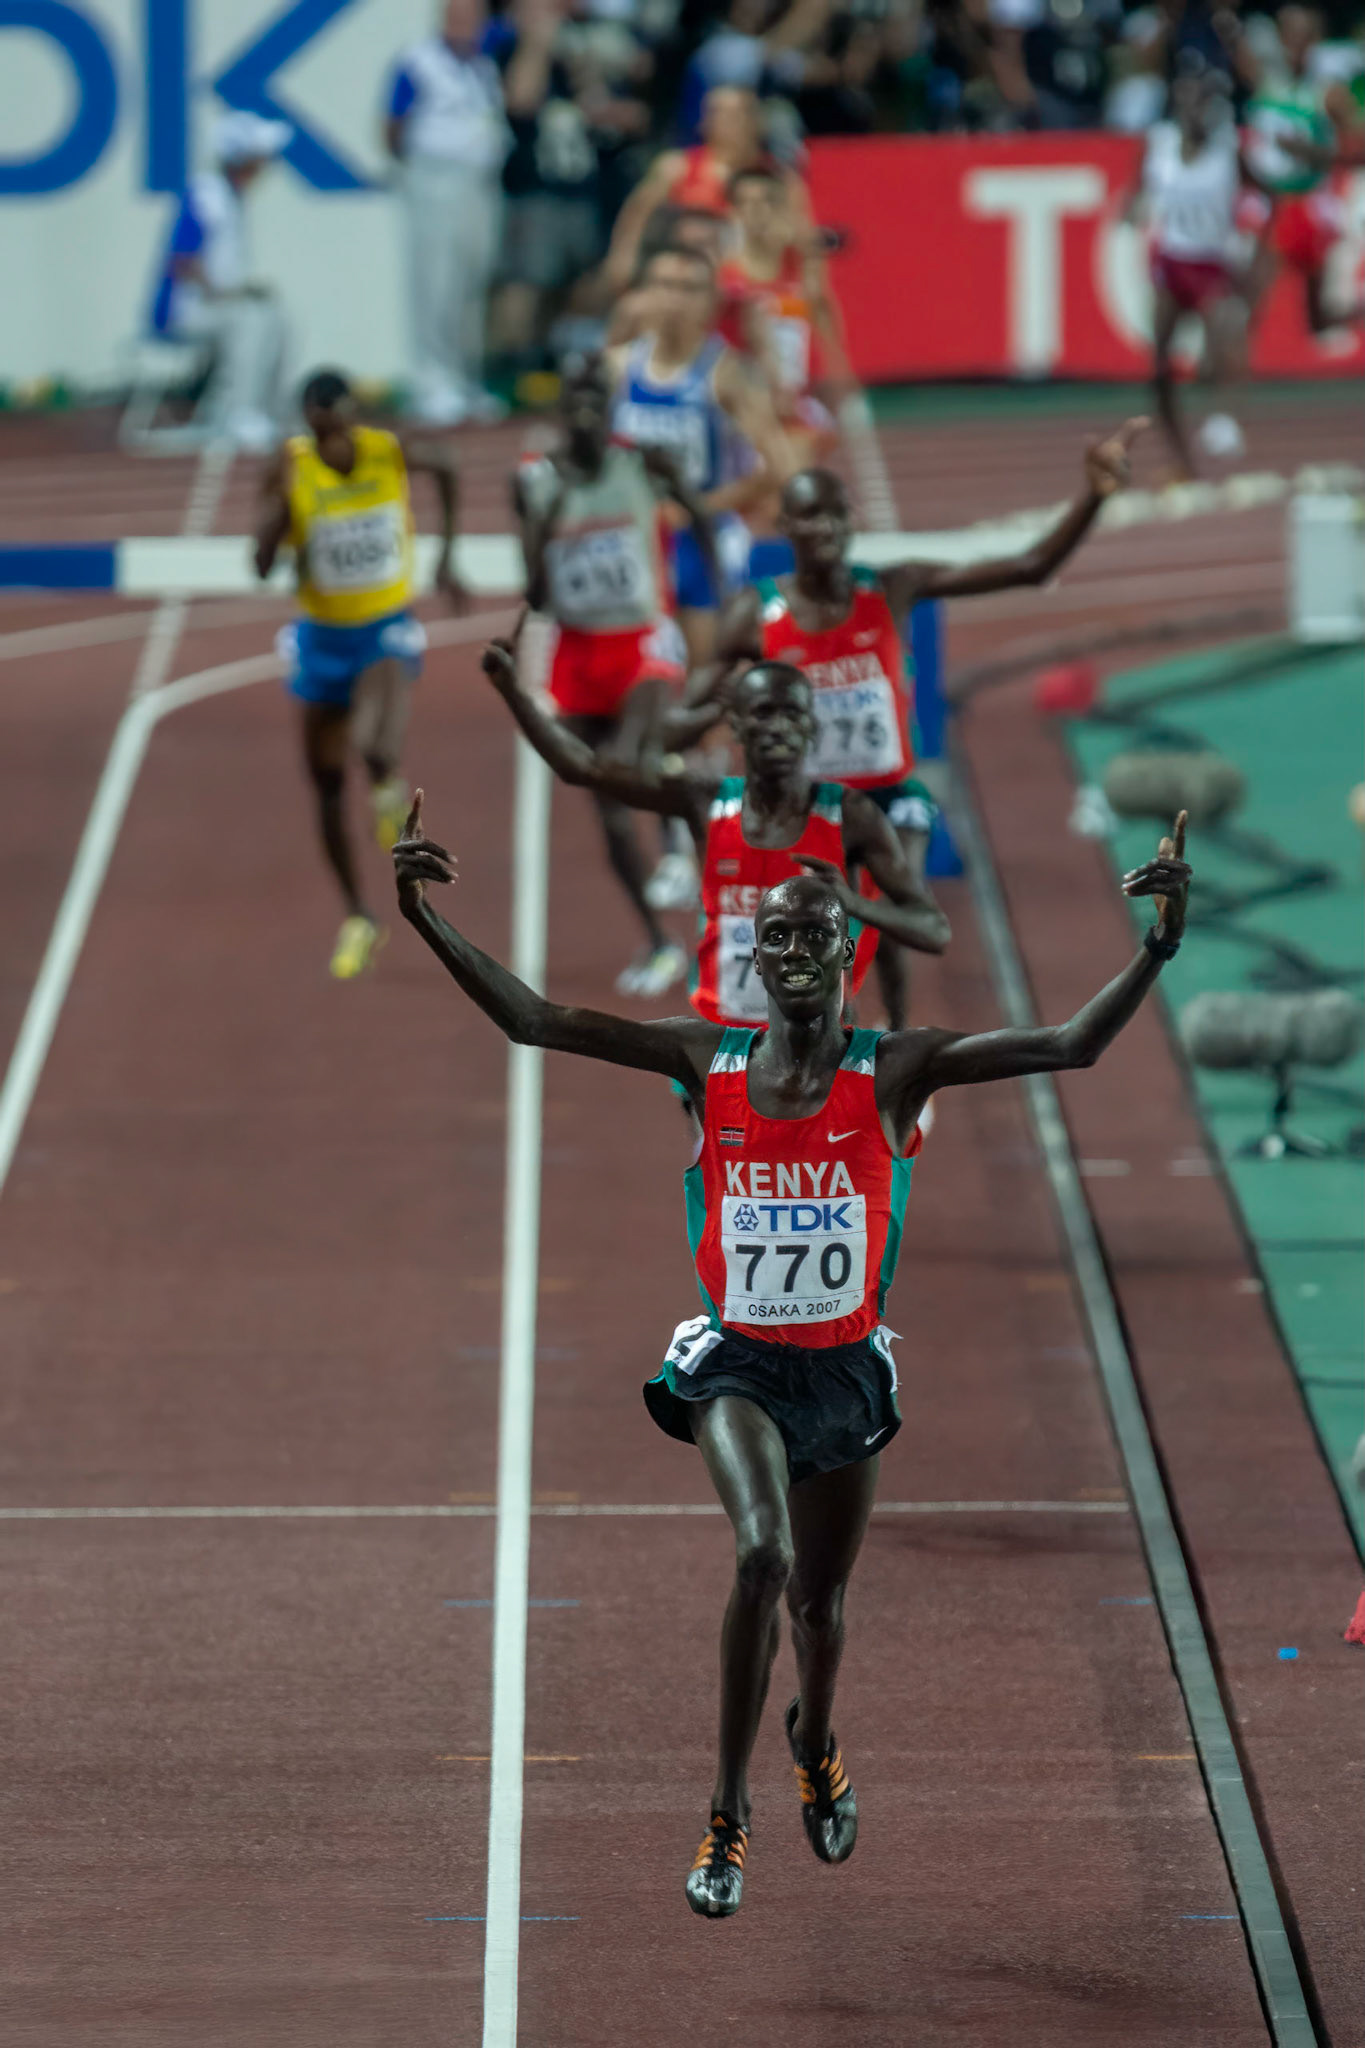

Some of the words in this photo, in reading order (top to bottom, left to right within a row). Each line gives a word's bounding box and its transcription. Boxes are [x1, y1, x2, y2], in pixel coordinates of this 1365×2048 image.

[725, 1160, 856, 1197] KENYA
[759, 1202, 853, 1232] TDK
[735, 1242, 852, 1293] 770
[748, 1303, 801, 1318] OSAKA
[806, 1299, 841, 1316] 2007
